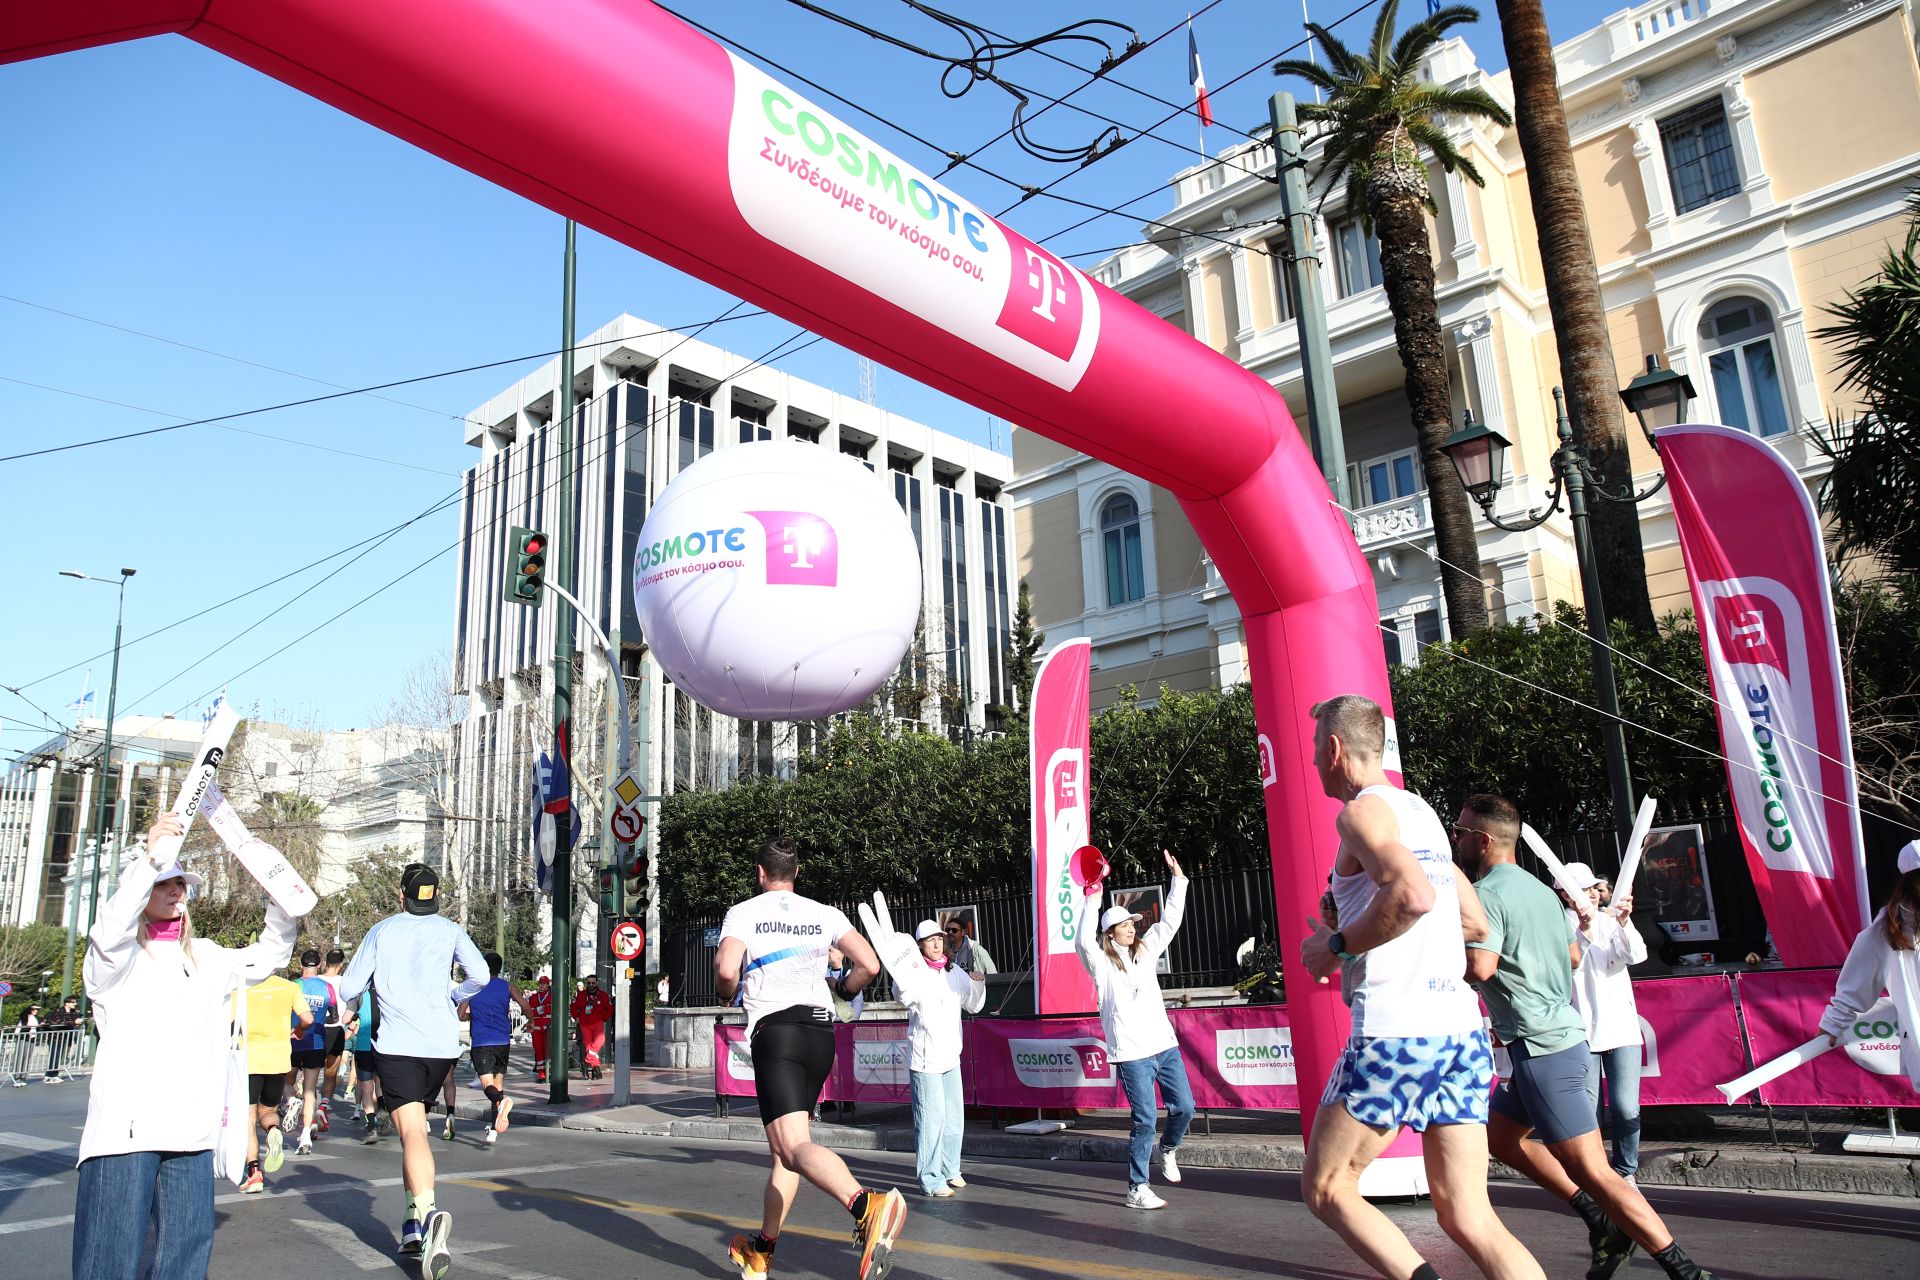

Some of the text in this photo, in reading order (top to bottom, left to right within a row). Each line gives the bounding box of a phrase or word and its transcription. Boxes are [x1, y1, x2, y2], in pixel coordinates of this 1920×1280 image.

[761, 89, 988, 253] COSMOTE
[759, 136, 985, 282] Συνδέουμε τον κόσμο σου.
[664, 567, 680, 578] τον
[681, 562, 717, 575] κόσμο
[718, 559, 745, 569] σου.
[185, 769, 213, 818] COSMOTE
[755, 921, 823, 936] KOUMPAROS
[858, 1053, 903, 1065] COSMOTE
[1016, 1053, 1074, 1066] COSMOTE
[1226, 1061, 1258, 1069] Συνδέουμε
